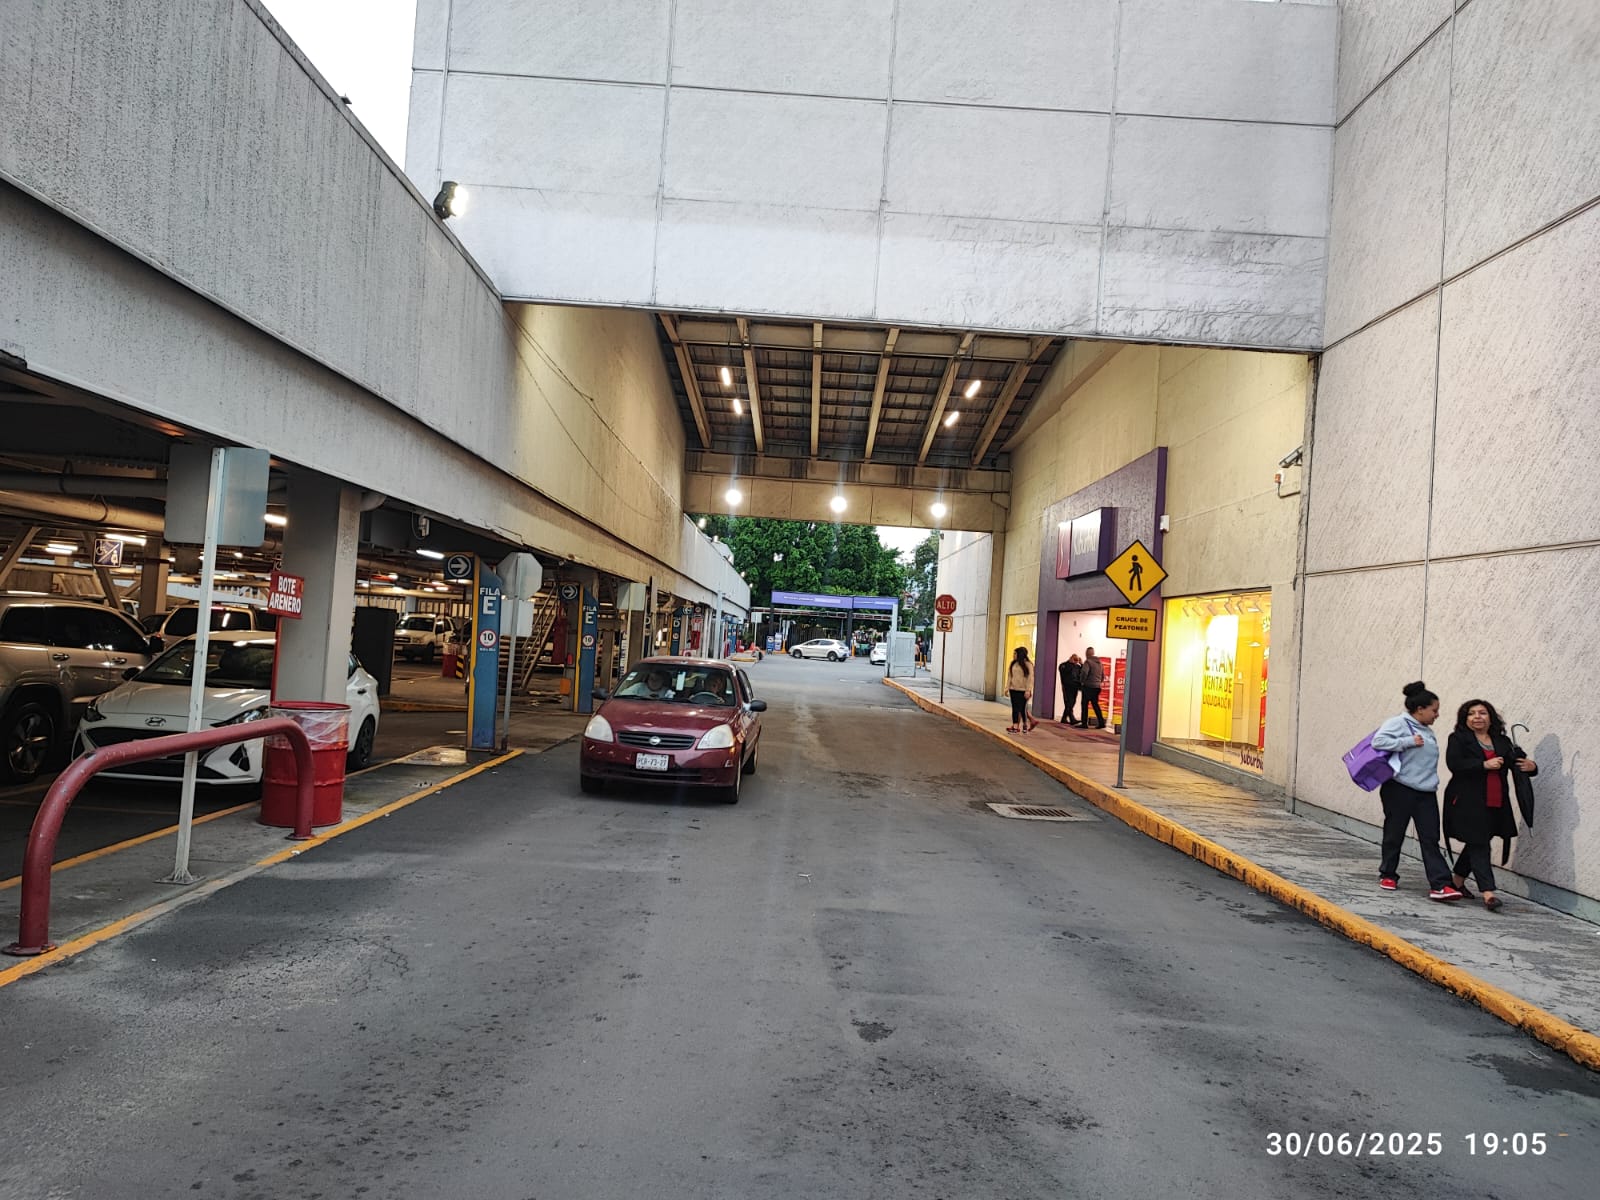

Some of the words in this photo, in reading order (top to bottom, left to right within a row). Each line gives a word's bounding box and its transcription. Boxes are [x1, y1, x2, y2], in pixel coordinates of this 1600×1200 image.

[278, 575, 297, 595] BOTE
[480, 587, 500, 596] FILA
[269, 592, 302, 613] ARENERO
[482, 596, 497, 615] E
[936, 600, 955, 610] ALTO
[585, 611, 594, 624] E
[673, 620, 681, 628] D
[941, 619, 949, 629] E
[1114, 624, 1148, 632] PEATONES
[482, 632, 494, 641] 10
[1205, 646, 1234, 674] GRAN
[1204, 675, 1223, 693] VENTA
[1223, 678, 1233, 694] DE
